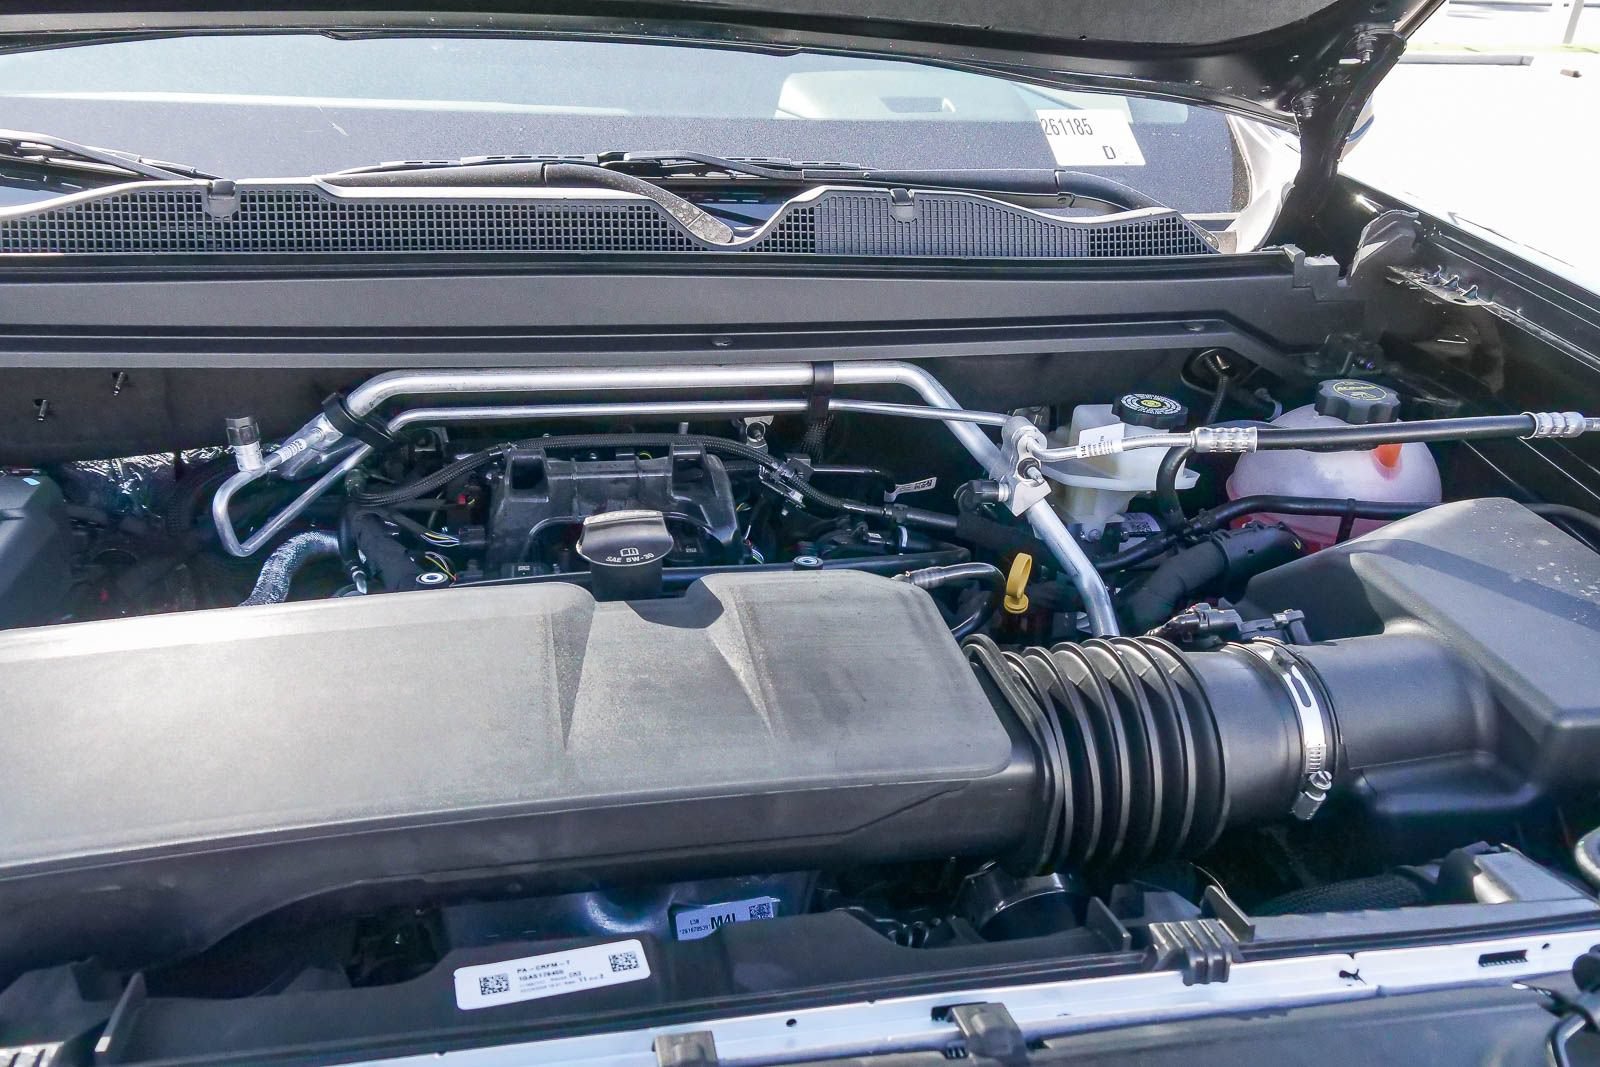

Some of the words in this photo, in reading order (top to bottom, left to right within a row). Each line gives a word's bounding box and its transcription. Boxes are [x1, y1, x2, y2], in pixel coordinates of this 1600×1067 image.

[1040, 118, 1093, 136] 261185
[605, 555, 622, 563] SAE
[626, 552, 655, 563] 5W-30
